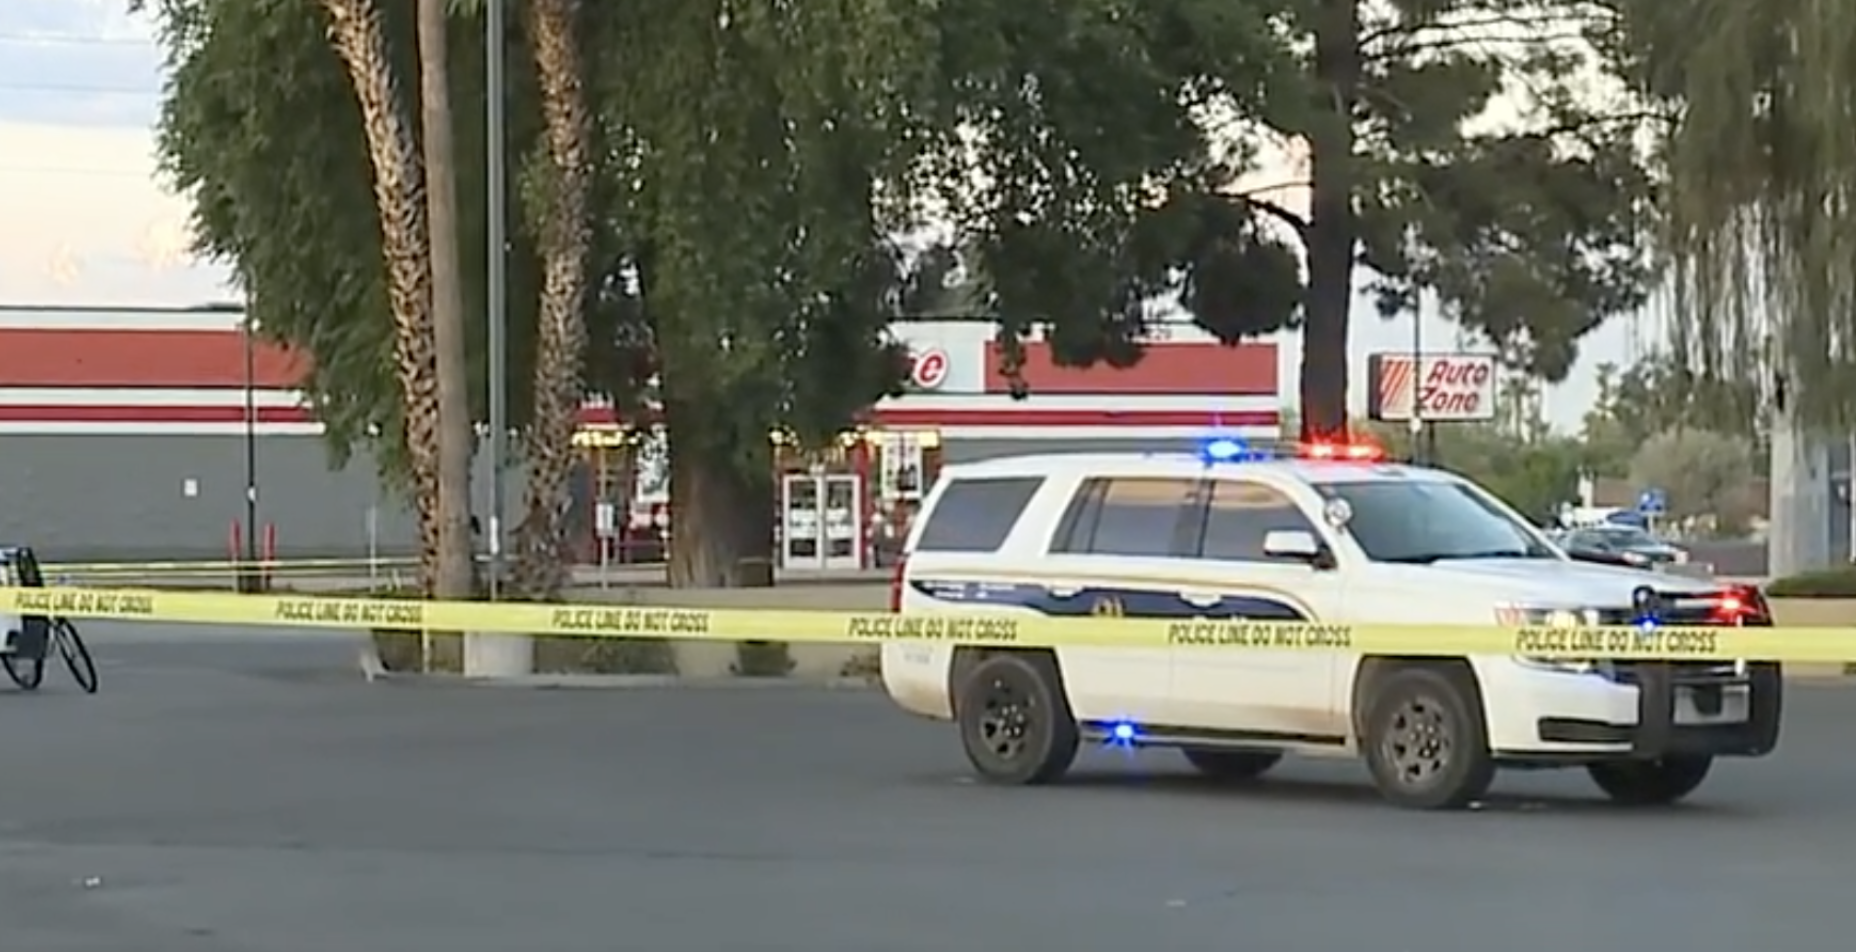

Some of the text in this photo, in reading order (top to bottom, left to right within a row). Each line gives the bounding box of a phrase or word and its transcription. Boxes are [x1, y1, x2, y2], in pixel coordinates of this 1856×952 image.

[1427, 361, 1489, 384] Auto
[1417, 388, 1479, 411] Zone
[15, 592, 153, 613] POLICE LINE DO NOT CROSS
[276, 600, 422, 623] POLICE LINE DO NOT CROSS
[553, 609, 709, 632] POLICE LINE DO NOT CROSS
[849, 617, 1017, 640] POLICE LINE DO NOT CROSS
[1168, 624, 1351, 646] POLICE LINE DO NOT CROSS
[1516, 629, 1717, 653] POLICE LINE DO NOT CROSS
